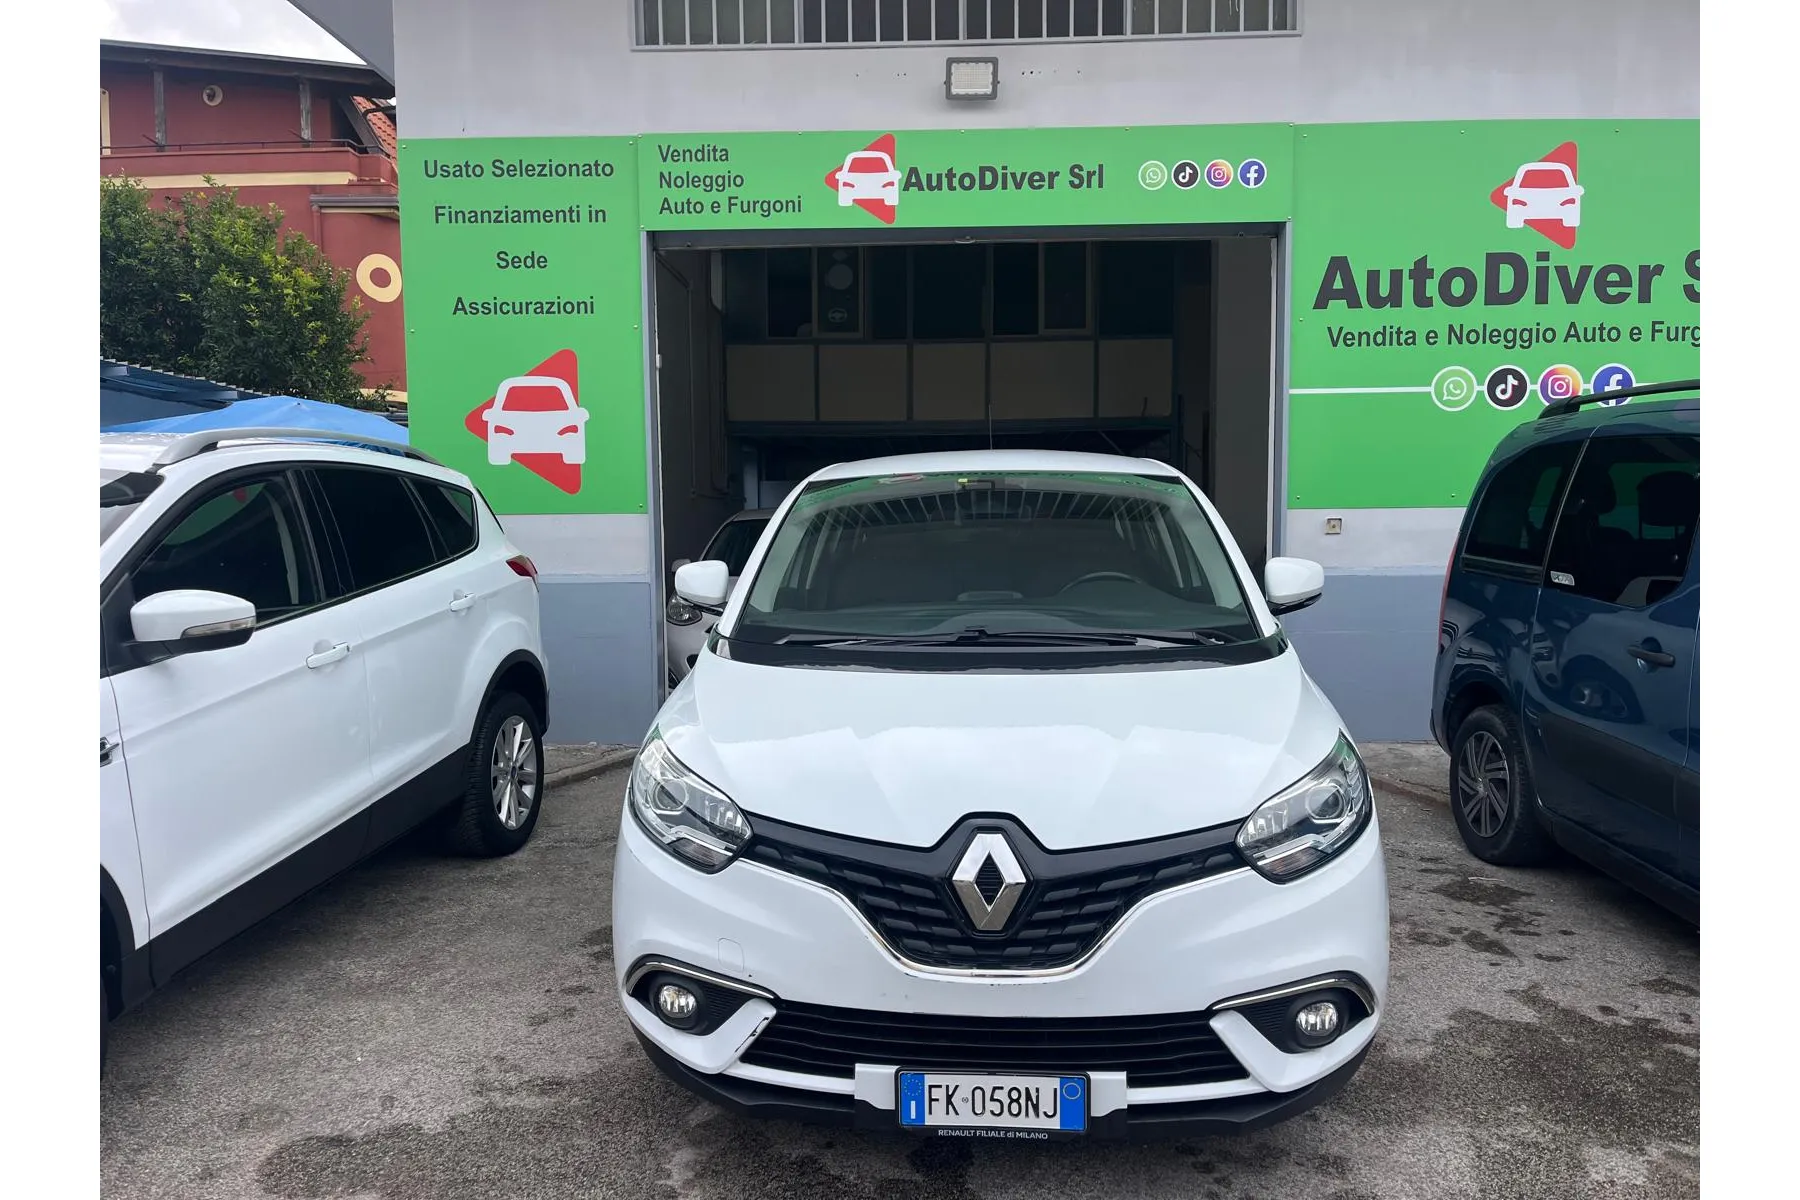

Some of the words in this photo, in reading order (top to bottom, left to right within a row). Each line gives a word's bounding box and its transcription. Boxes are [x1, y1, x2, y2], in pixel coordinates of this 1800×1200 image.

[657, 143, 729, 163] Vendita
[424, 159, 485, 179] Usato
[491, 158, 614, 178] Selezionato
[902, 165, 1061, 192] AutoDiver
[1068, 163, 1104, 190] Srl
[659, 170, 745, 193] Noleggio
[434, 204, 581, 224] Finanziamenti
[588, 204, 607, 223] in
[659, 196, 705, 215] Auto
[710, 200, 721, 214] e
[727, 195, 802, 218] Furgoni
[496, 250, 548, 270] Sede
[1312, 250, 1665, 310] AutoDiver
[452, 295, 595, 316] Assicurazioni
[1326, 325, 1417, 348] Vendita
[1425, 329, 1439, 346] e
[1447, 321, 1557, 350] Noleggio
[1563, 321, 1622, 343] Auto
[1628, 326, 1643, 343] e
[938, 1129, 975, 1137] RENAULT
[976, 1130, 1006, 1138] FILIALE
[1015, 1131, 1048, 1140] MILANO
